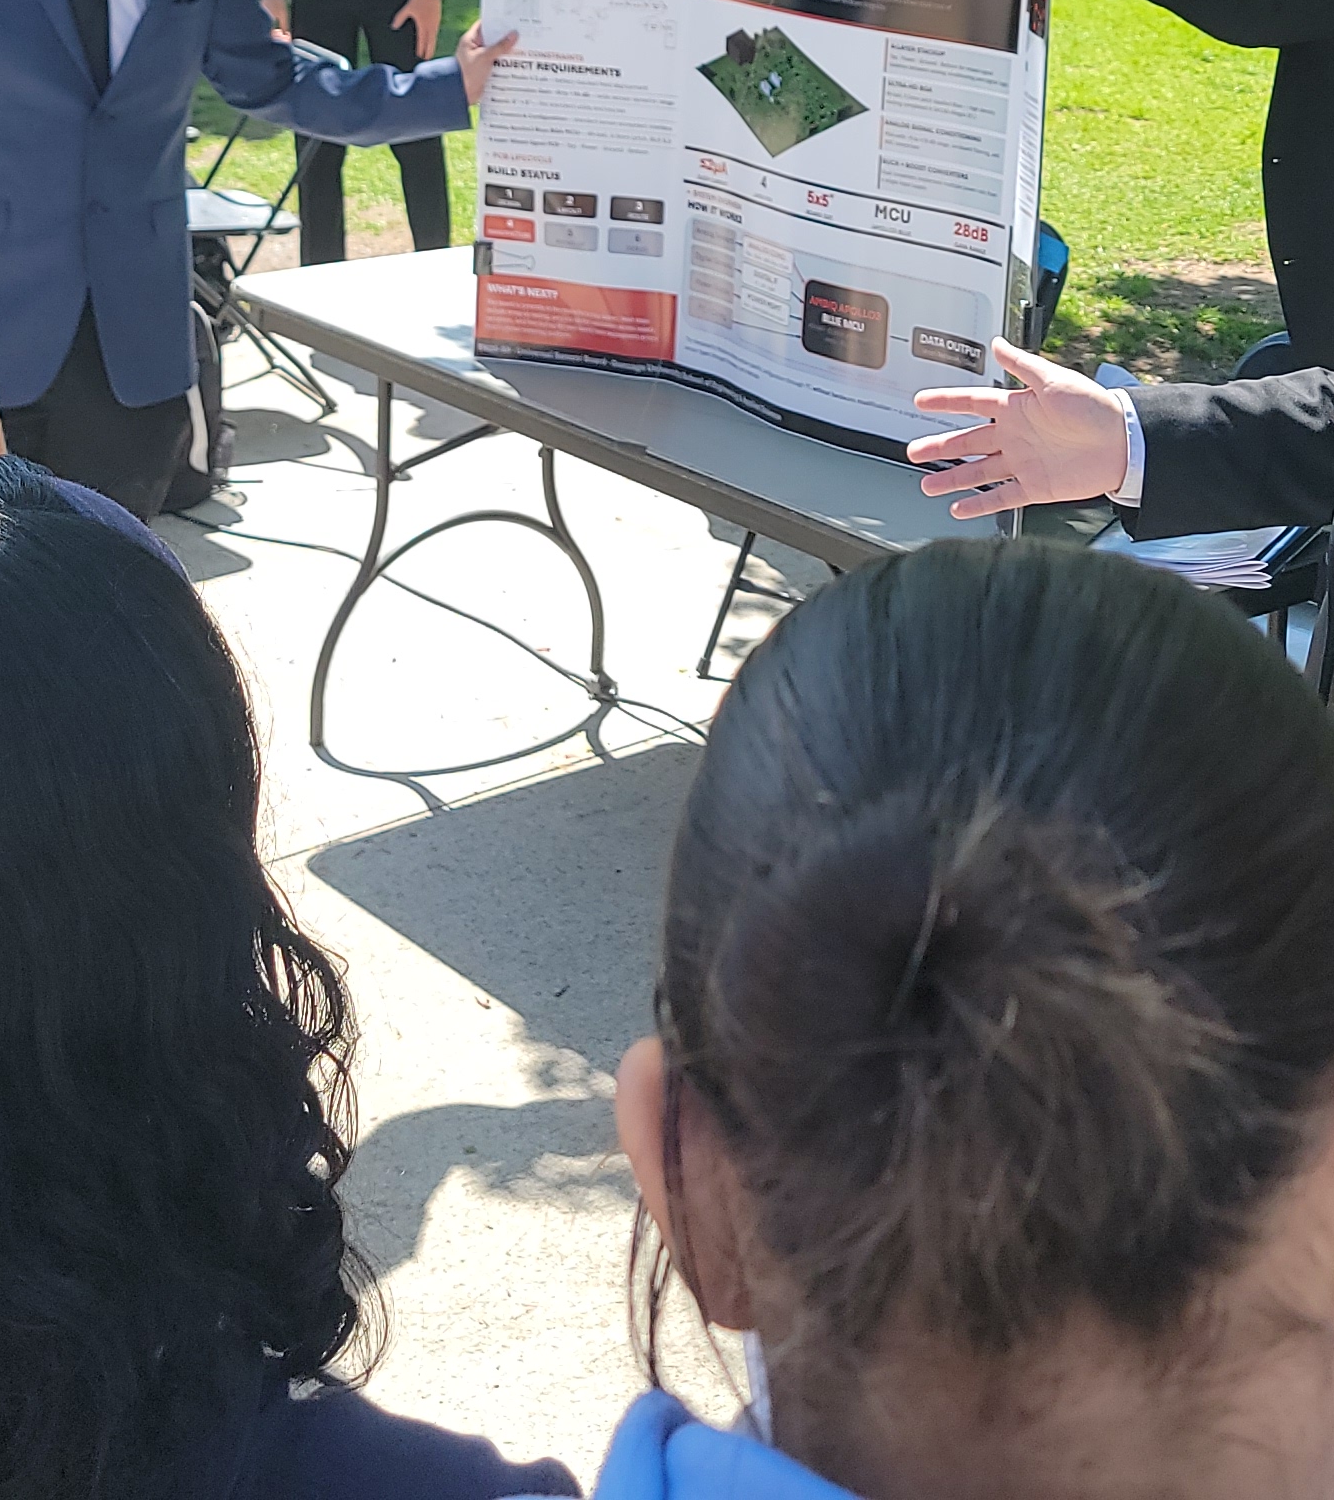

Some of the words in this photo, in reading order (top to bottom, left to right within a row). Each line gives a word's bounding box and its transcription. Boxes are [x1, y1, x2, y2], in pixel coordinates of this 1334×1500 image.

[493, 58, 533, 70] ROJECT
[536, 62, 621, 77] REQUIREMENTS
[487, 165, 518, 176] BUILD
[520, 168, 561, 180] STATUS
[635, 200, 644, 211] 3
[874, 203, 911, 223] MCU
[954, 221, 989, 242] 28dB
[821, 312, 842, 327] BLUE
[843, 318, 865, 332] MCU
[920, 333, 945, 348] DATA
[946, 340, 982, 357] OUTPUT
